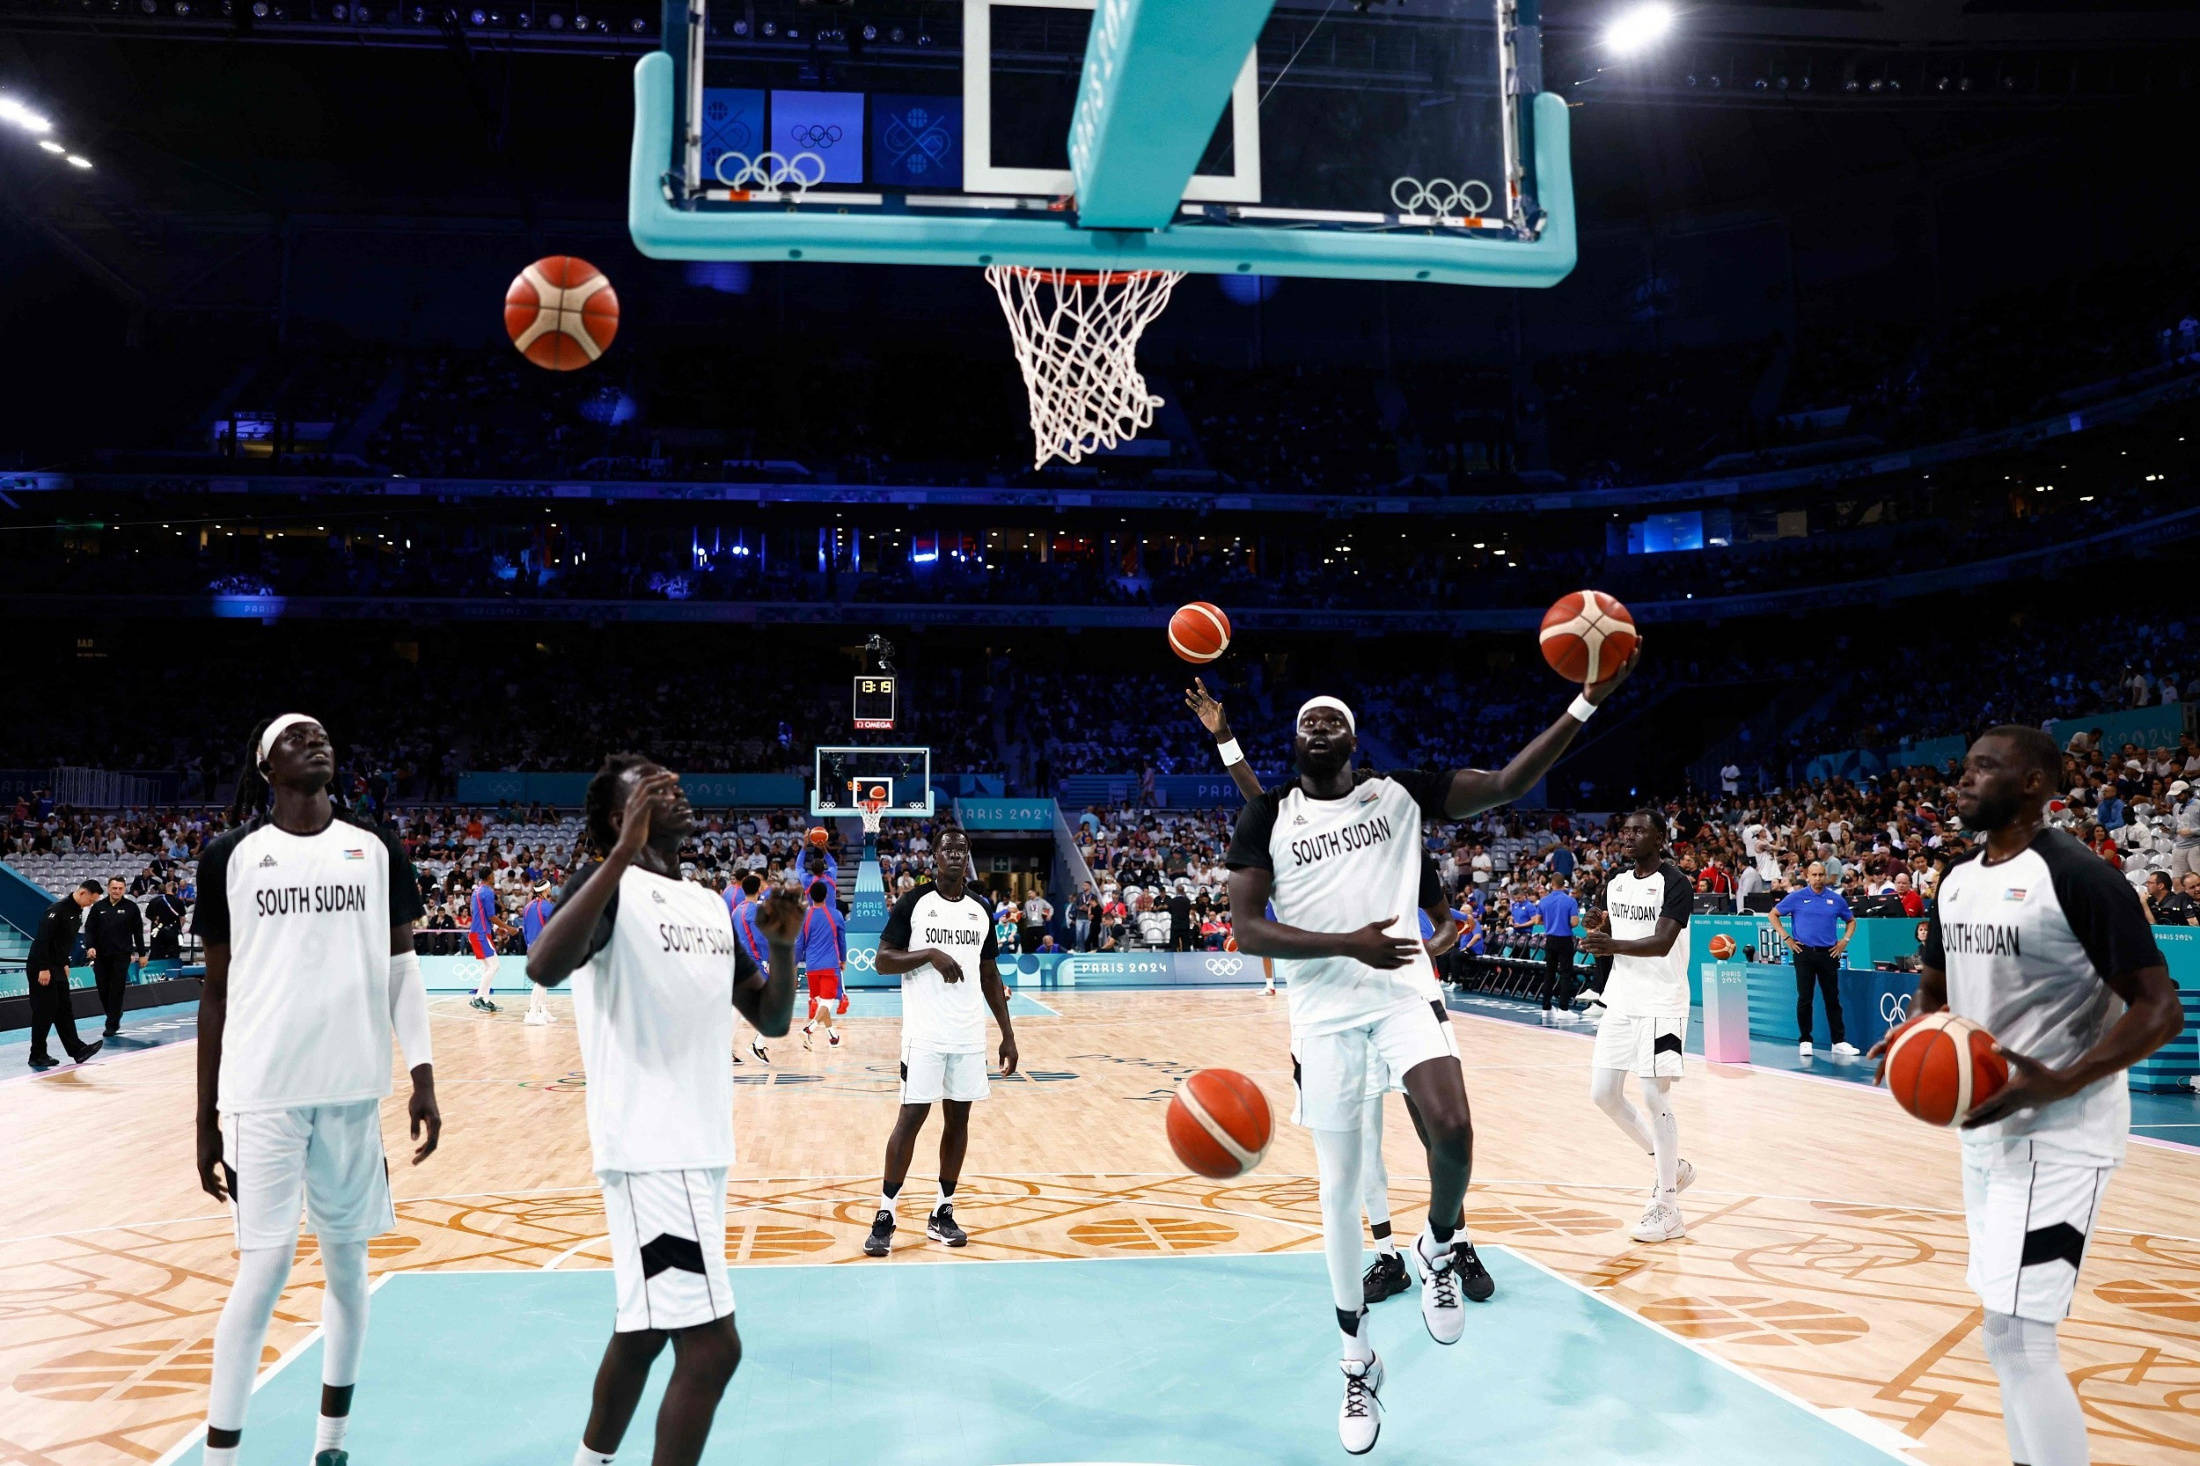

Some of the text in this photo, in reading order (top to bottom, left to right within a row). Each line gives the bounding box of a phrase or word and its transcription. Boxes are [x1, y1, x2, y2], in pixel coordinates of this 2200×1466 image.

[862, 680, 892, 693] 13:19
[1009, 808, 1053, 820] 2024
[1291, 815, 1392, 867] SOUTH SUDAN
[256, 884, 366, 917] SOUTH SUDAN
[856, 901, 883, 910] PARIS
[856, 909, 883, 917] 2024
[1611, 901, 1656, 921] SOUTH SUDAN
[660, 923, 708, 954] SOUTH
[925, 927, 981, 946] SOUTH SUDAN
[1941, 922, 2021, 957] OUTH SUDAN
[2154, 933, 2193, 941] PARIS 2024
[1081, 962, 1168, 974] PARIS 2024
